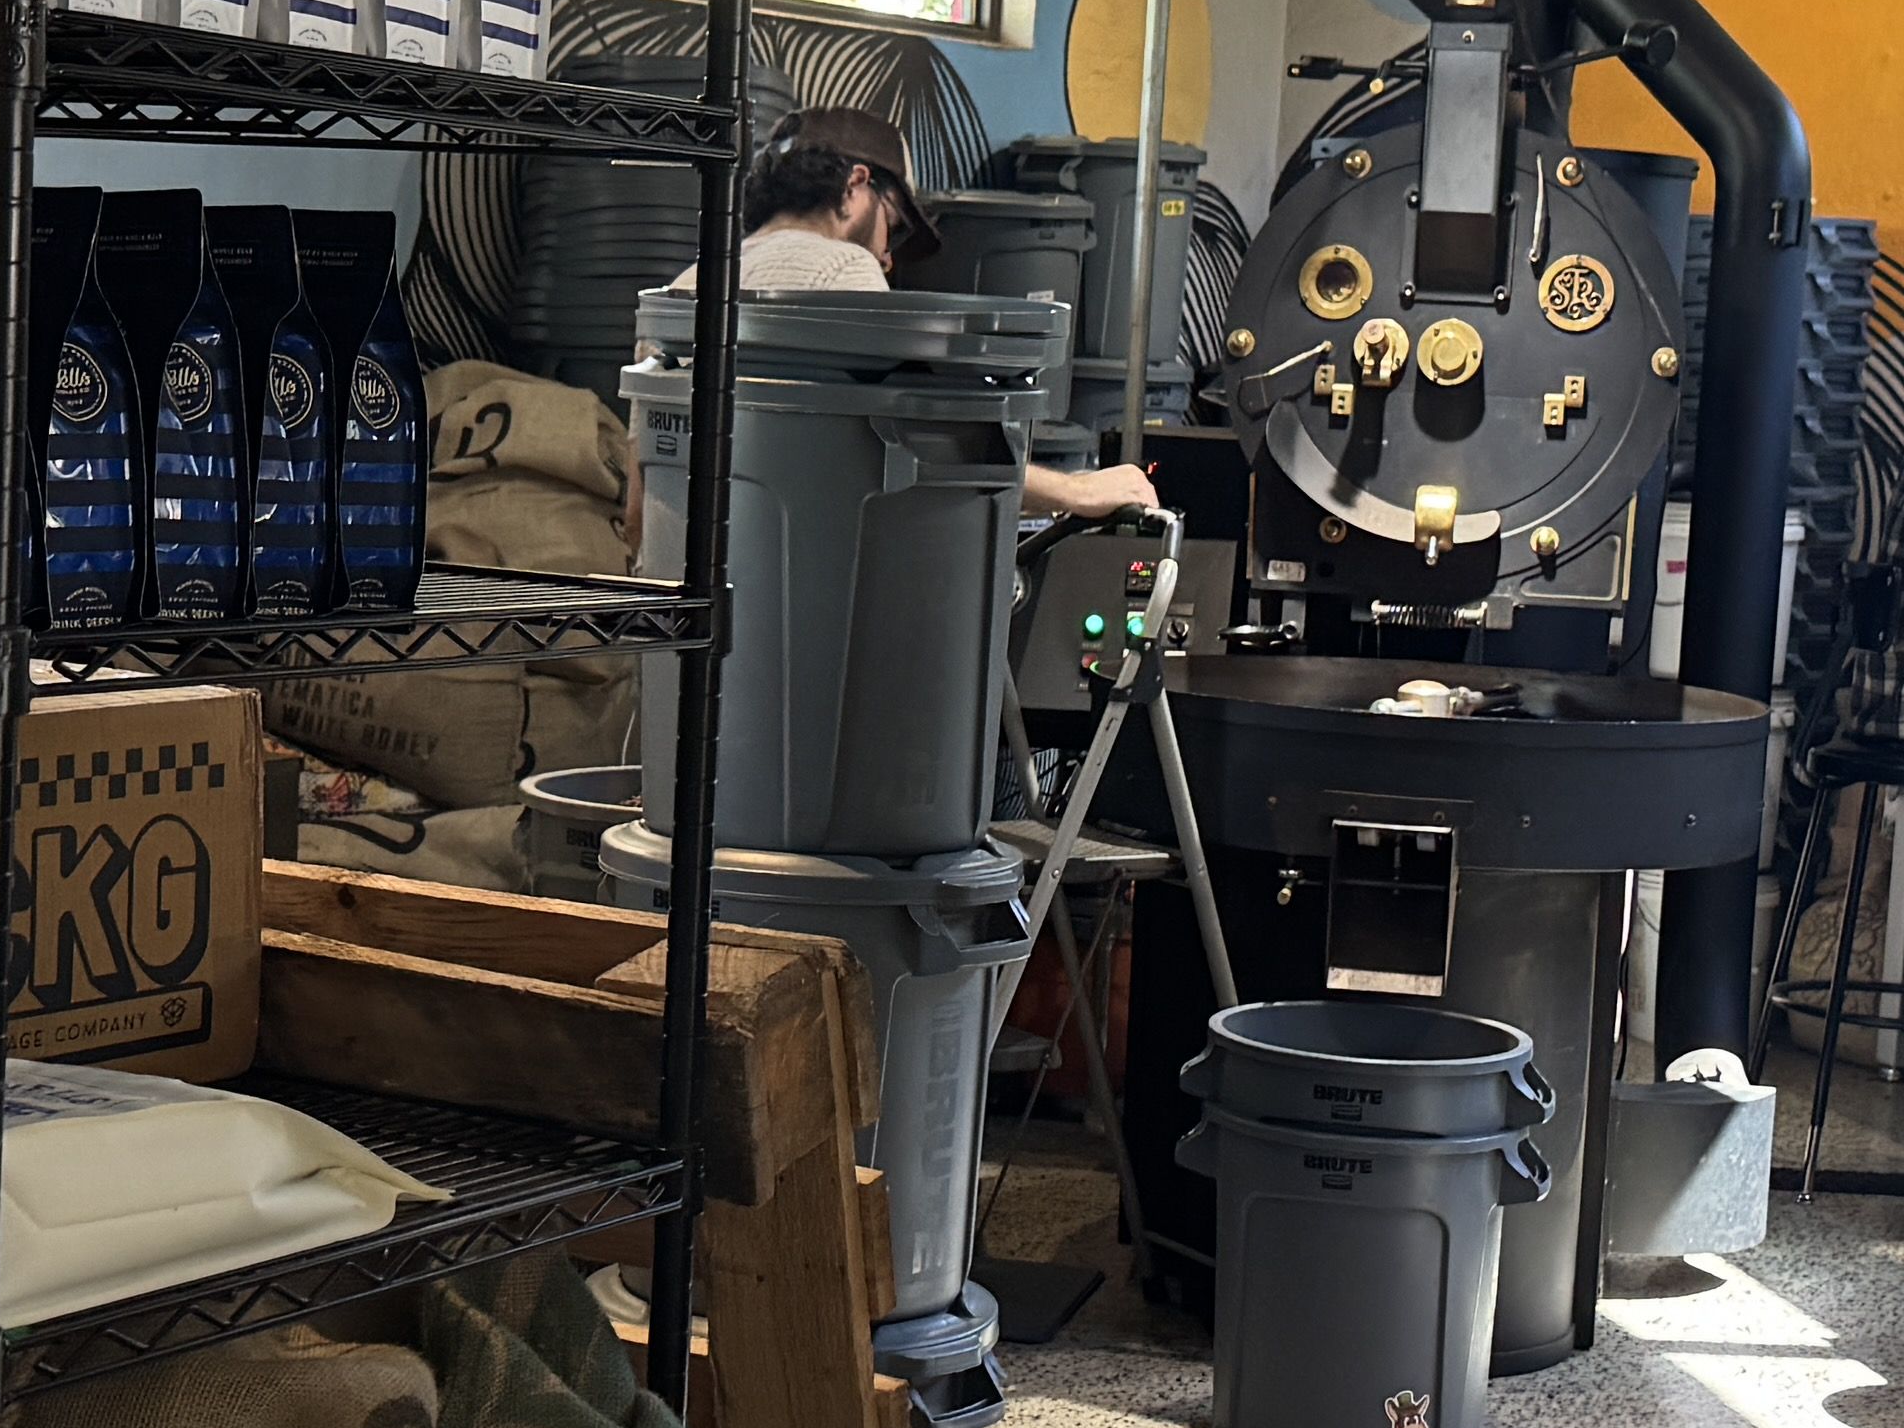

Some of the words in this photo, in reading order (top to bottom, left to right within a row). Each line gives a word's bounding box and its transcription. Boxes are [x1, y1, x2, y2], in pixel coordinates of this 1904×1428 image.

[54, 1011, 148, 1045] COMPANY
[1313, 1083, 1383, 1106] BRUTE
[1303, 1154, 1373, 1174] BRUTE
